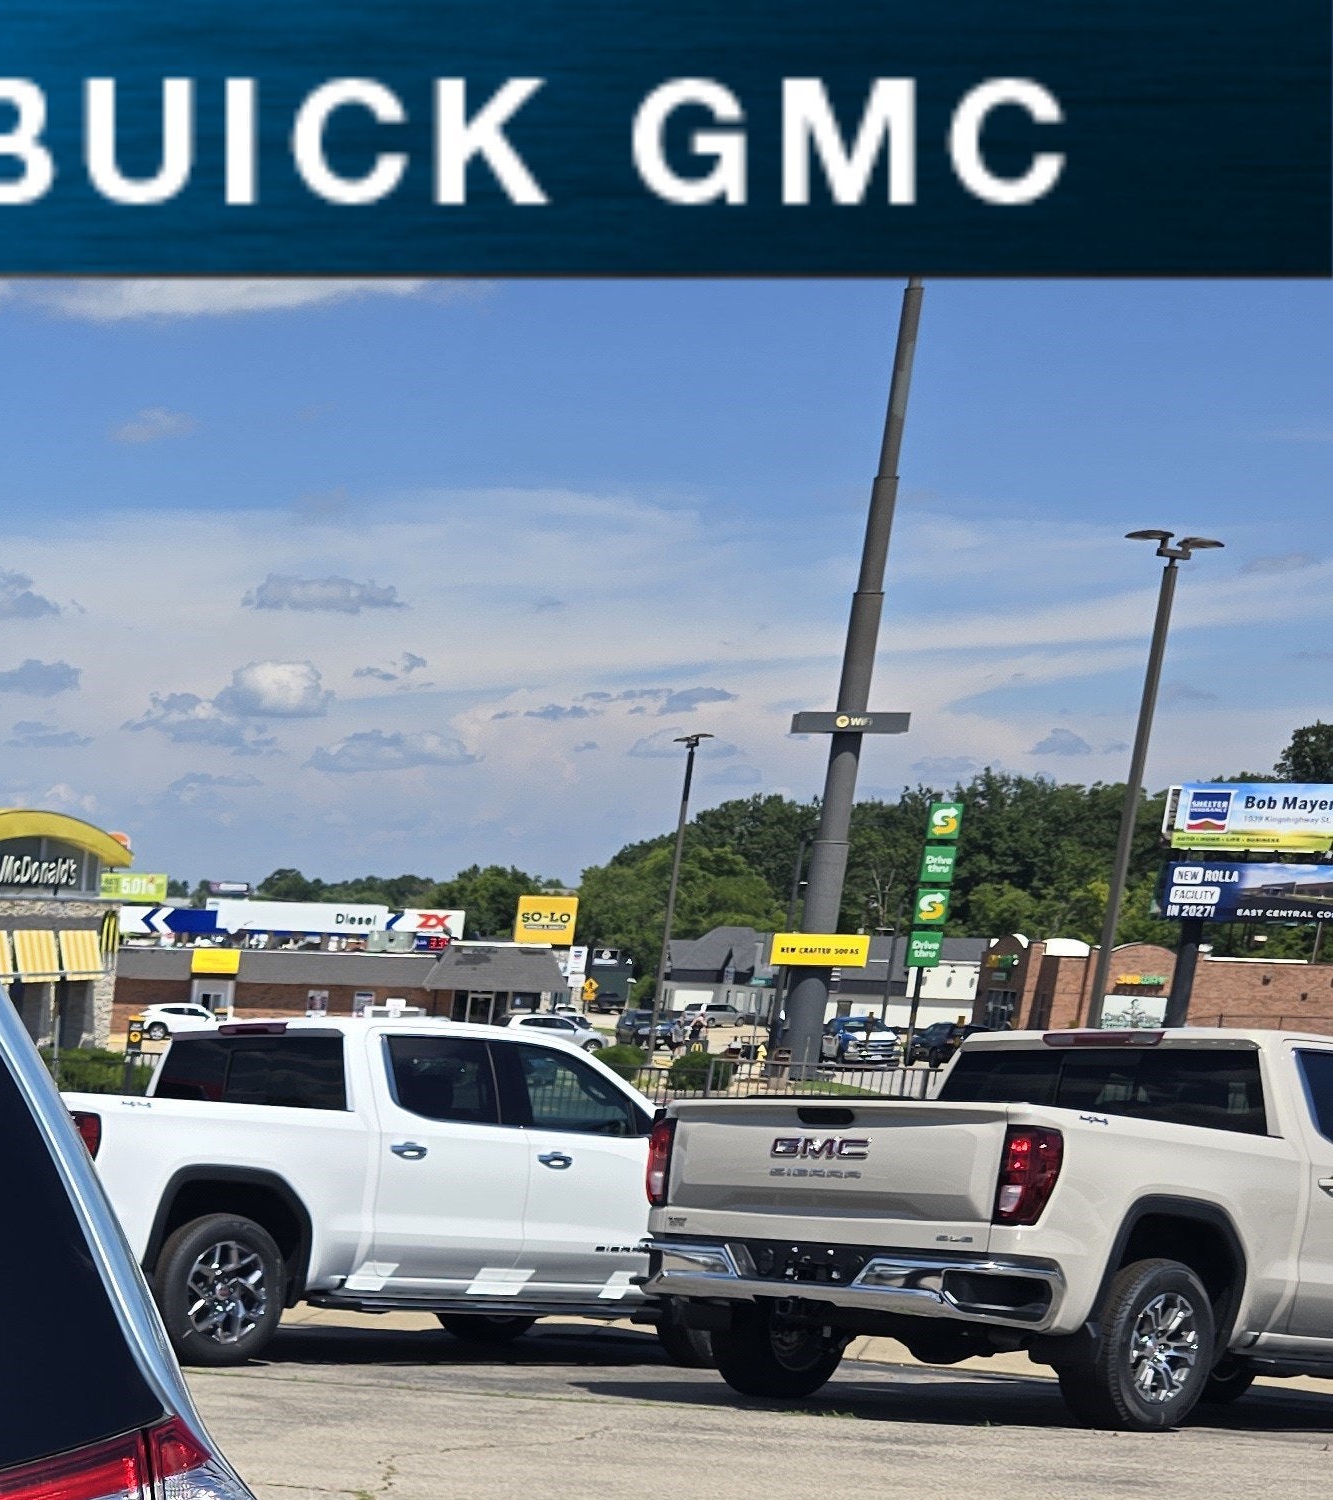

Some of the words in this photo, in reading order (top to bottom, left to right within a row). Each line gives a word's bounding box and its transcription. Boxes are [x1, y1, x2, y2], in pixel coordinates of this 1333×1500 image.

[1244, 796, 1277, 810] Bob
[926, 855, 953, 866] Drive
[927, 864, 950, 873] thru
[1177, 870, 1200, 881] NEW
[1204, 870, 1239, 882] ROLLA
[1173, 889, 1215, 901] FACILITY
[1166, 905, 1180, 917] IN
[1236, 908, 1263, 917] EAST
[1265, 909, 1314, 918] CENTRAL
[1316, 910, 1333, 919] CO
[335, 913, 377, 926] Diesel
[780, 946, 796, 954] NEW
[798, 947, 832, 955] CRAFTED
[912, 940, 940, 951] Drive
[914, 949, 936, 958] thru
[770, 1136, 873, 1160] GMC
